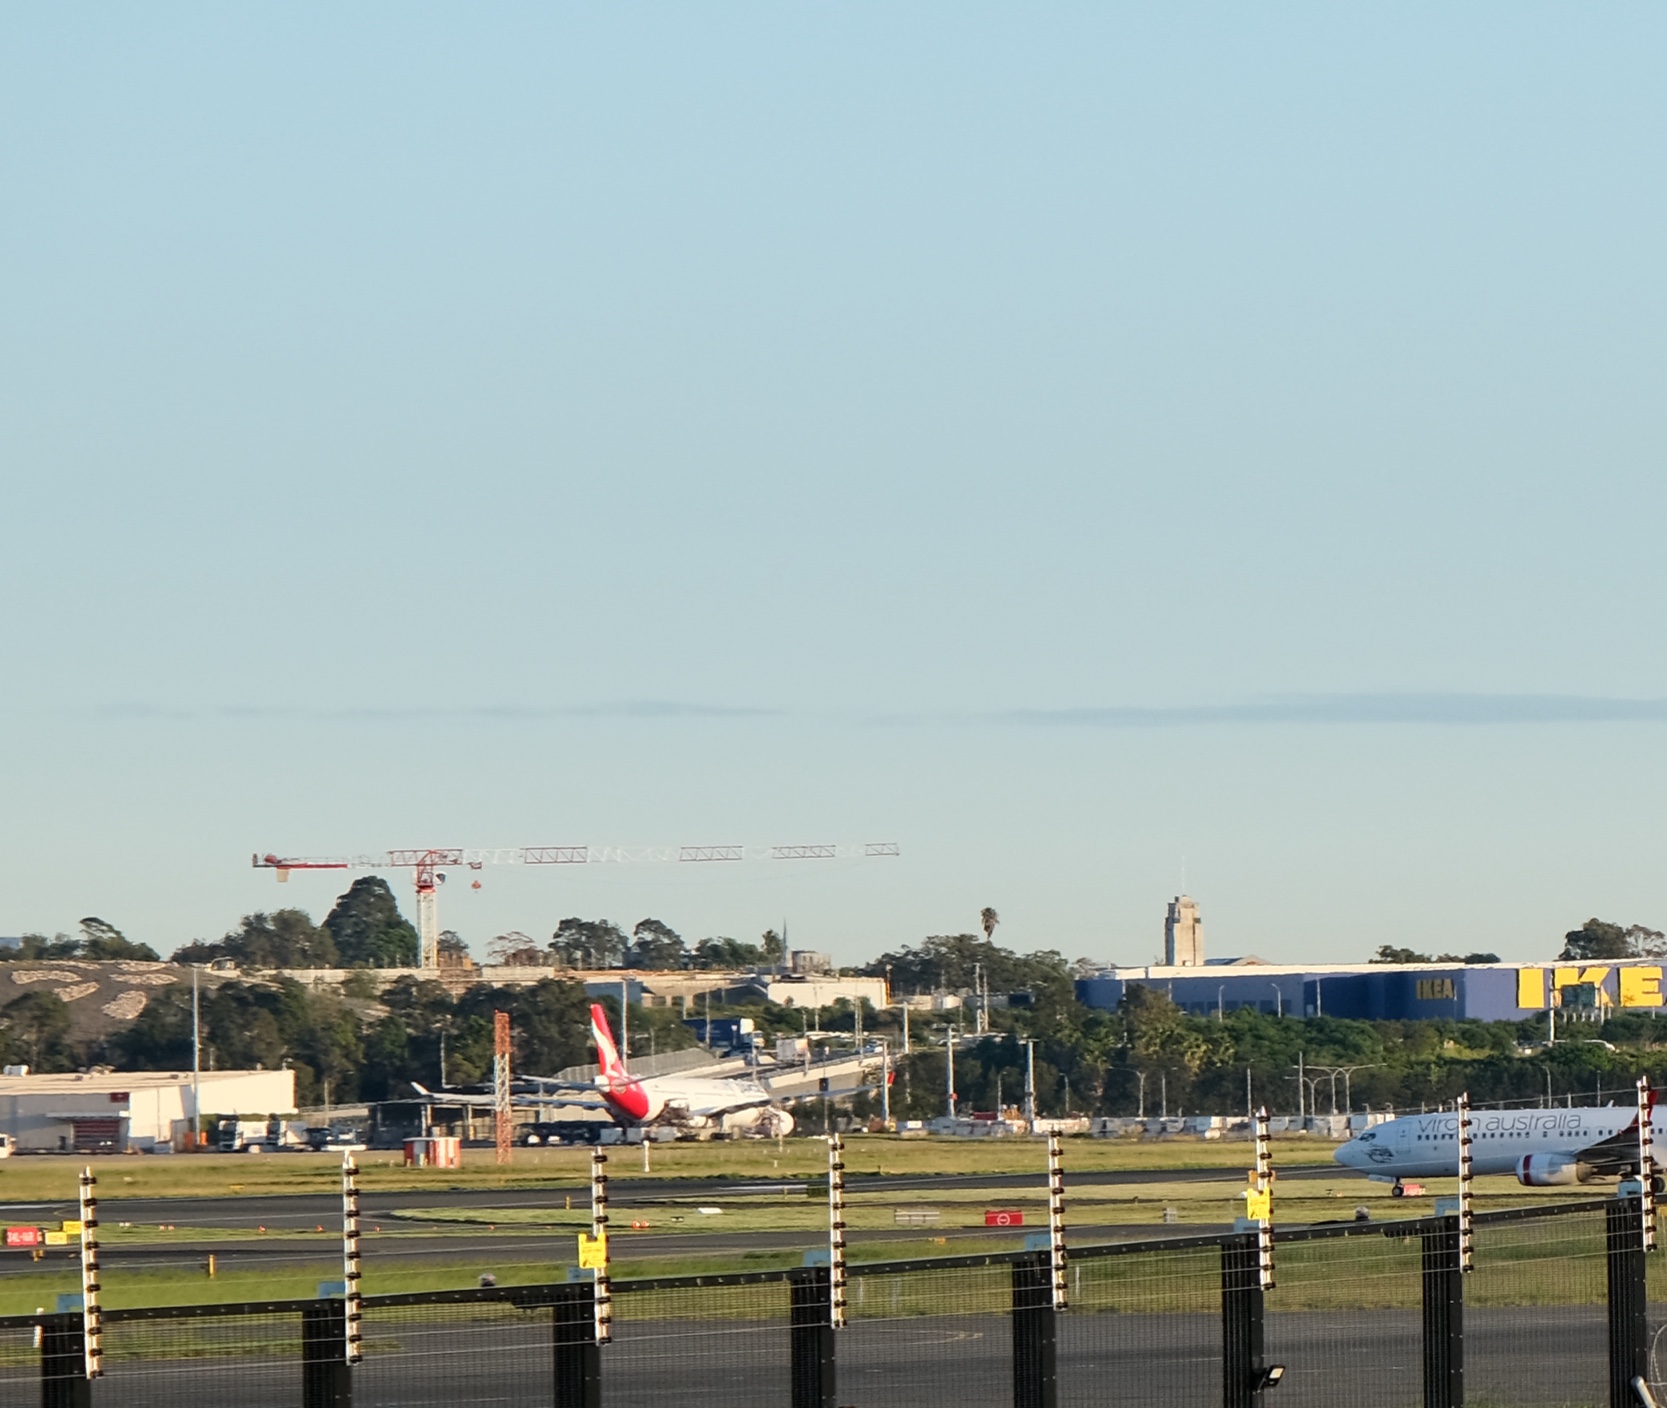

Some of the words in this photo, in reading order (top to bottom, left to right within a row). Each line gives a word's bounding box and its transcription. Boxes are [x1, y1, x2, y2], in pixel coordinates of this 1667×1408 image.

[1415, 978, 1455, 1000] IKEA
[1418, 1116, 1481, 1135] virgn
[1485, 1113, 1581, 1131] australia
